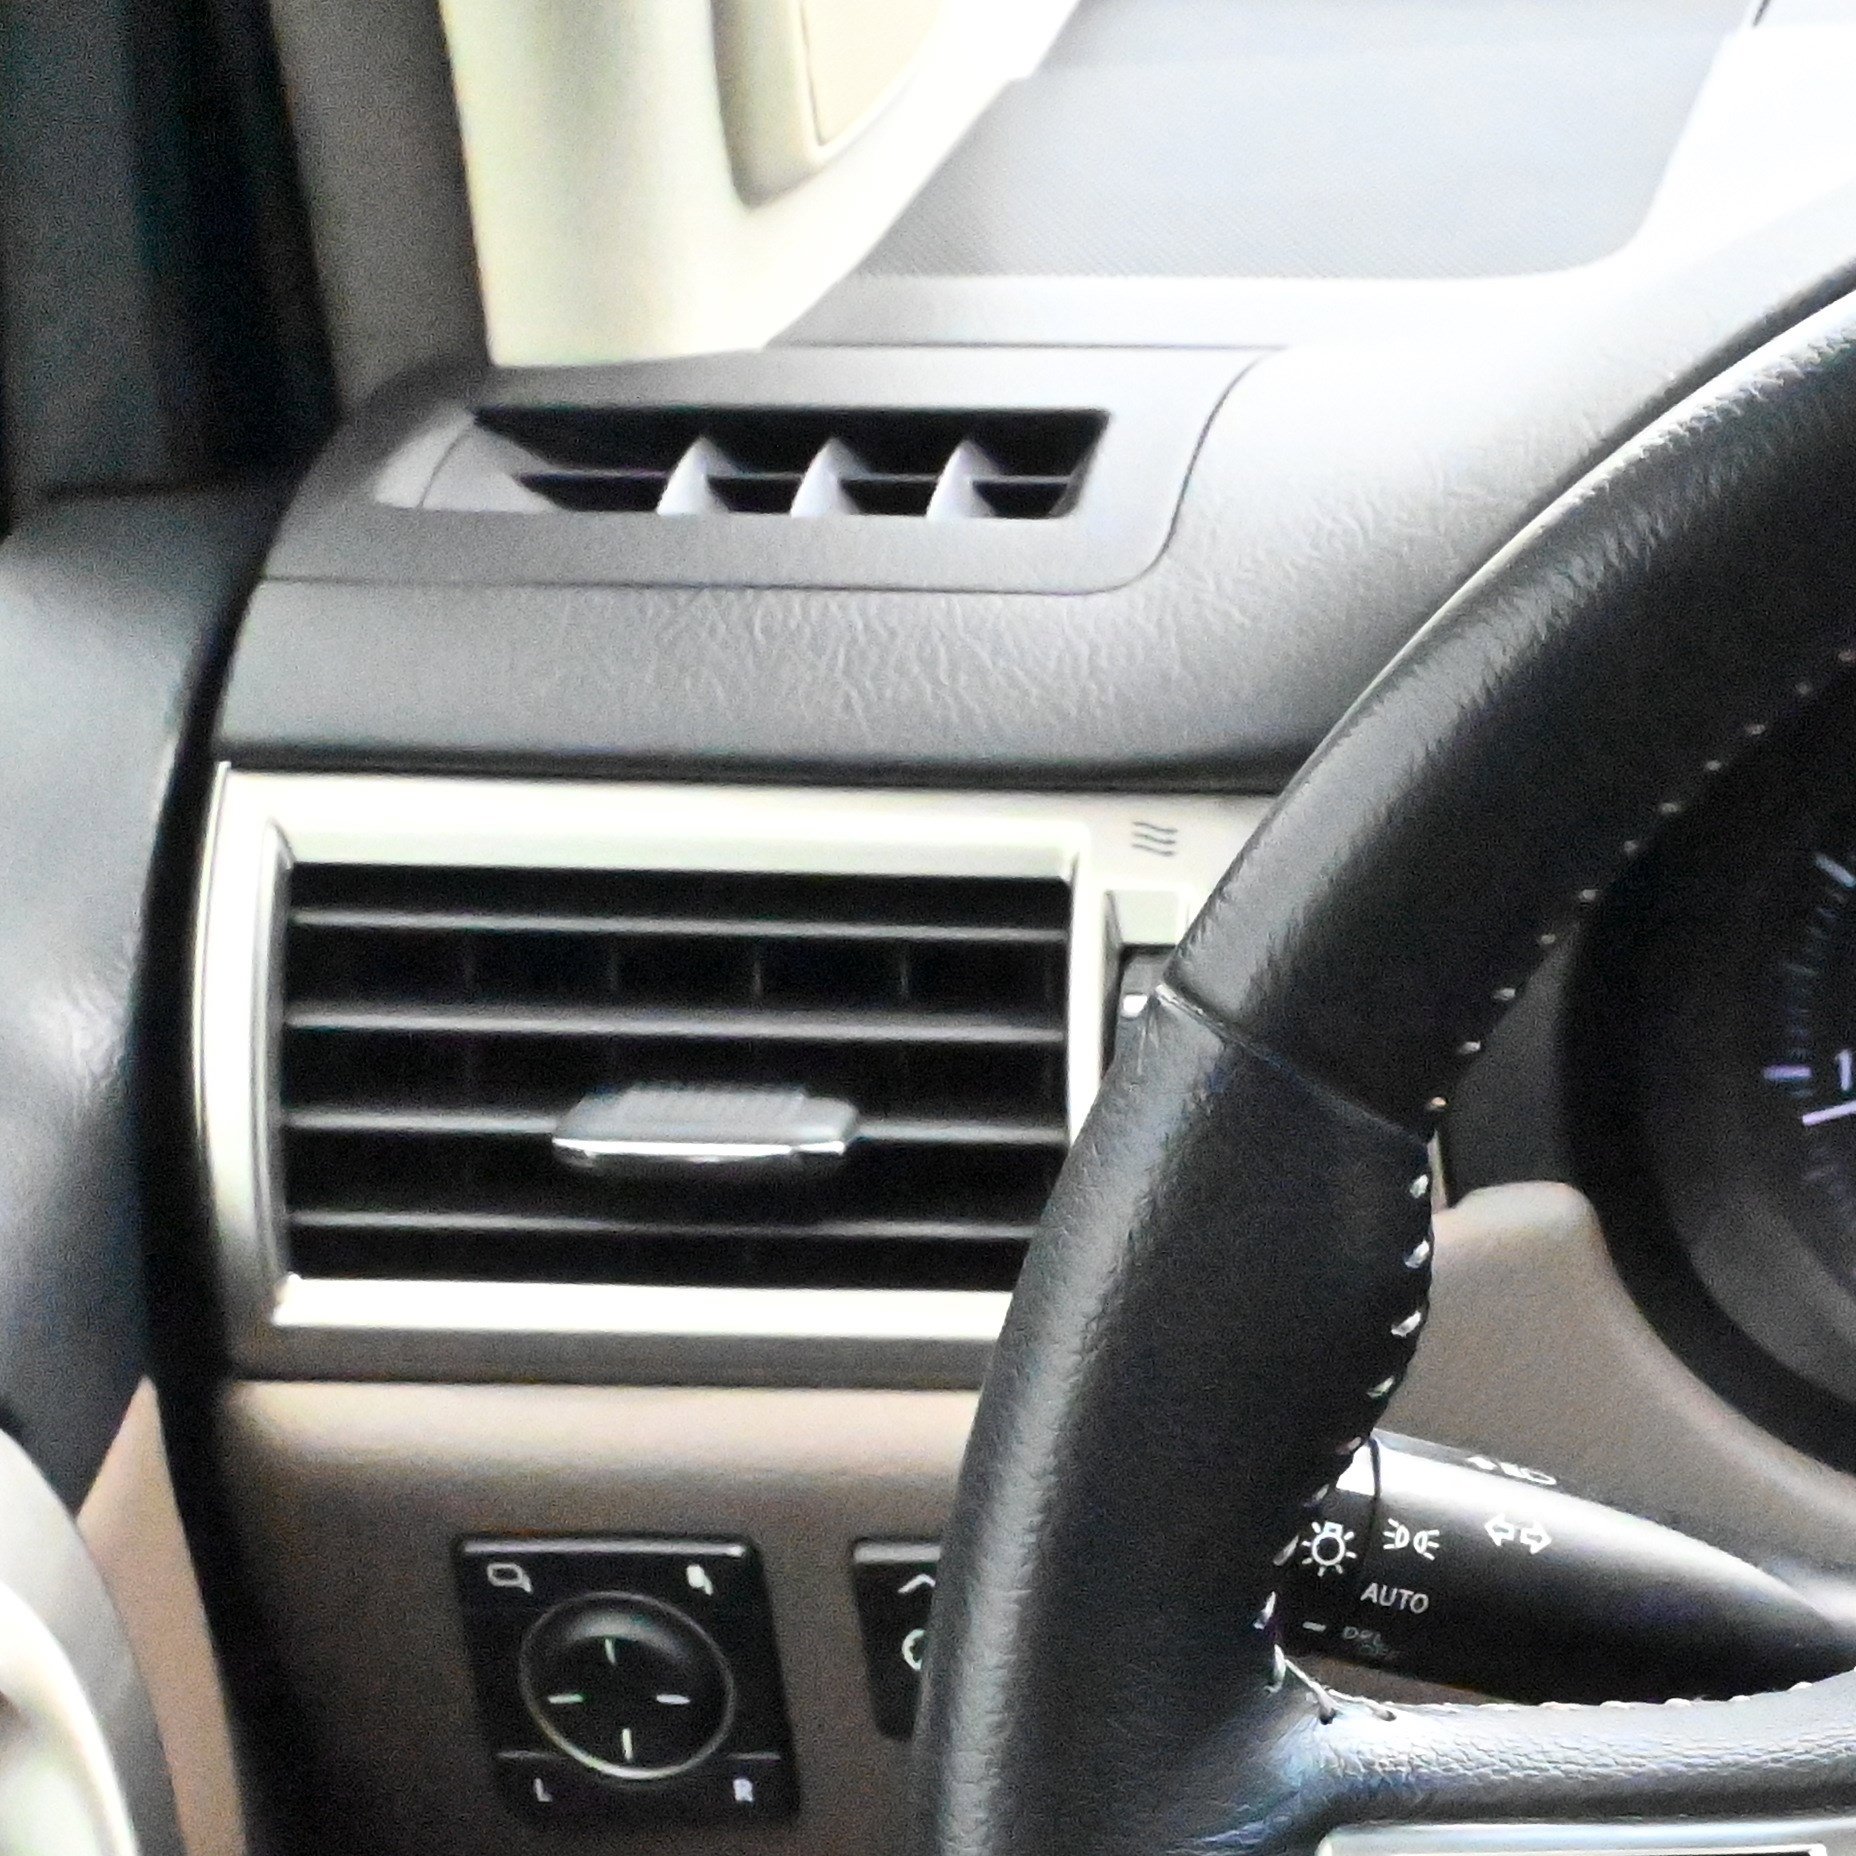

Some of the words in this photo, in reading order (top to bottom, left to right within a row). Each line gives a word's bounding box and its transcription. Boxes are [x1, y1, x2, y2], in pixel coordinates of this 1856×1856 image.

[1836, 1051, 1852, 1090] 1
[1360, 1582, 1429, 1614] AUTO
[534, 1777, 553, 1801] L
